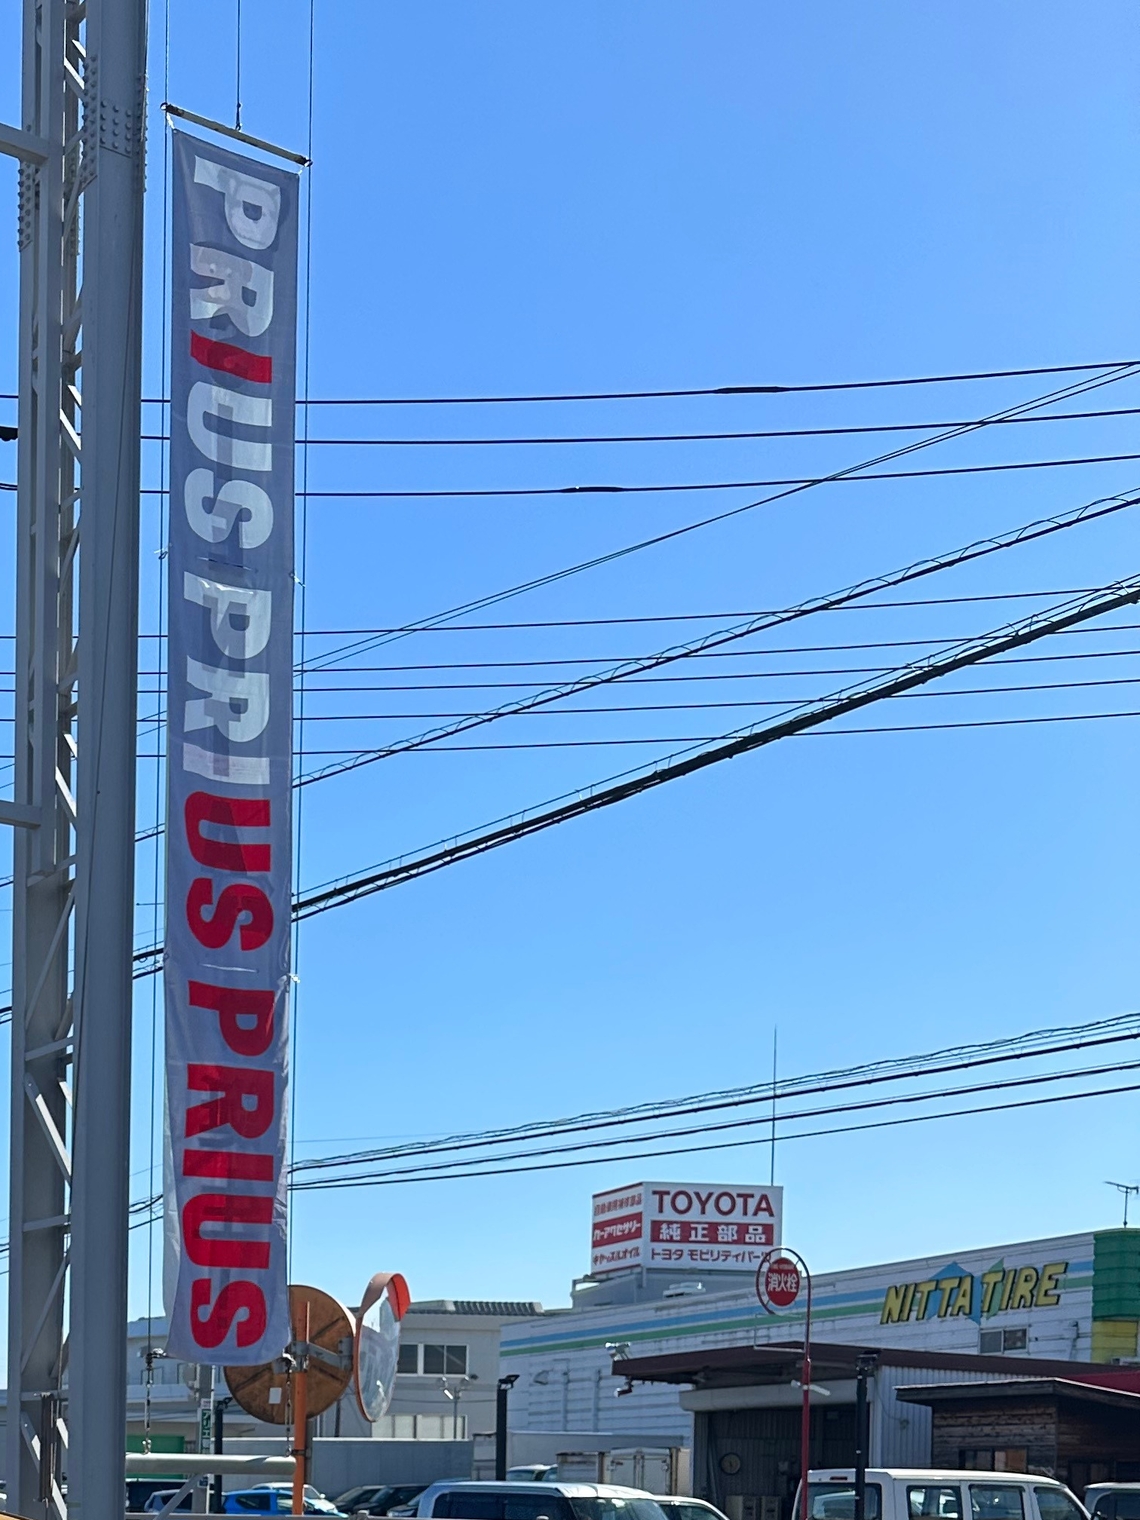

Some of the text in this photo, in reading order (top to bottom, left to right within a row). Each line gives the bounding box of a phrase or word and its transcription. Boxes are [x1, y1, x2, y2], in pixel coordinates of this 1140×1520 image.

[182, 154, 282, 1350] PRIUS PRIUS PRIUS
[652, 1190, 775, 1218] TOYOTA
[659, 1223, 766, 1244] 純正部品
[767, 1272, 799, 1293] 消火栓
[880, 1262, 1069, 1325] NITTA TIRE
